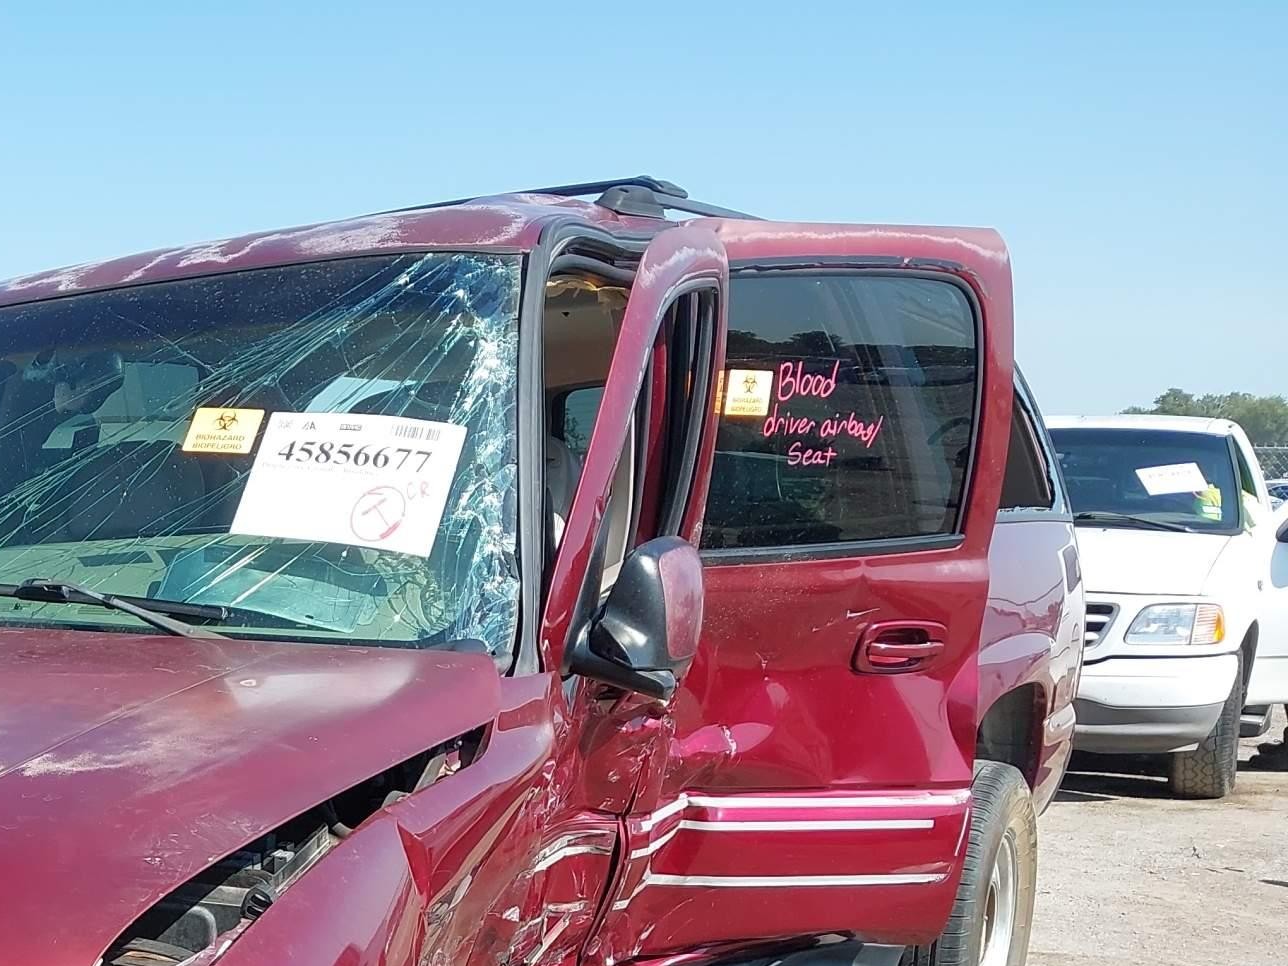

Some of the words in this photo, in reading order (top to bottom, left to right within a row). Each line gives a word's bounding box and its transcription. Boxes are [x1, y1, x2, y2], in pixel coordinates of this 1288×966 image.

[778, 360, 840, 401] Blood
[763, 404, 816, 437] driver
[278, 440, 433, 473] 45856677
[787, 442, 838, 466] Seat
